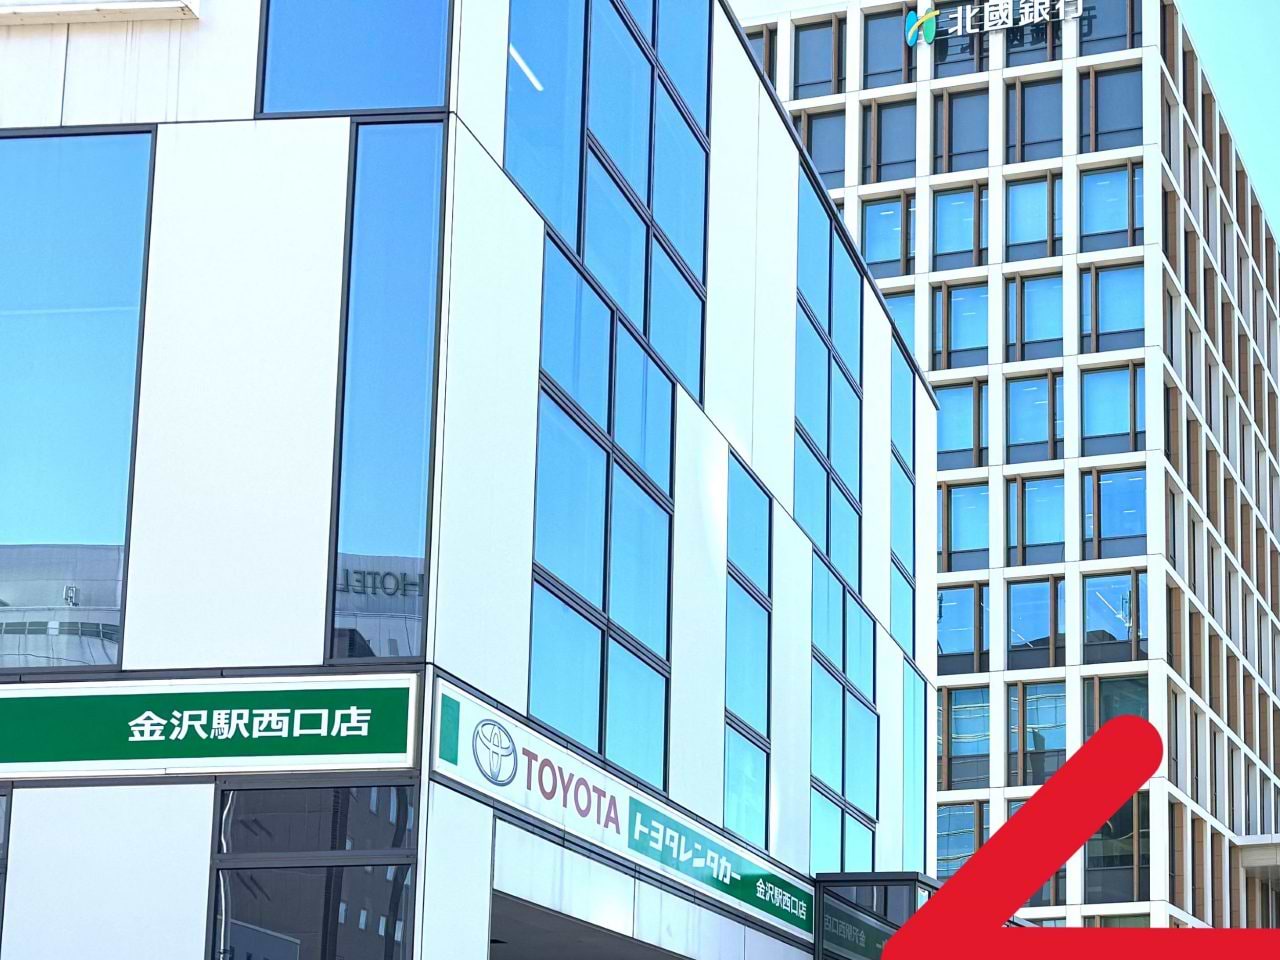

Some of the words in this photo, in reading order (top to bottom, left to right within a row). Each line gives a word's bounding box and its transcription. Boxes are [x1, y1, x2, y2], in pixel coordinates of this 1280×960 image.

[949, 0, 1083, 36] 北國銀行
[127, 705, 372, 742] 金沢駅西口店
[522, 747, 621, 835] TOYOTA
[633, 811, 741, 885] トヨタレンタカー
[755, 878, 807, 920] 金沢駅西口店
